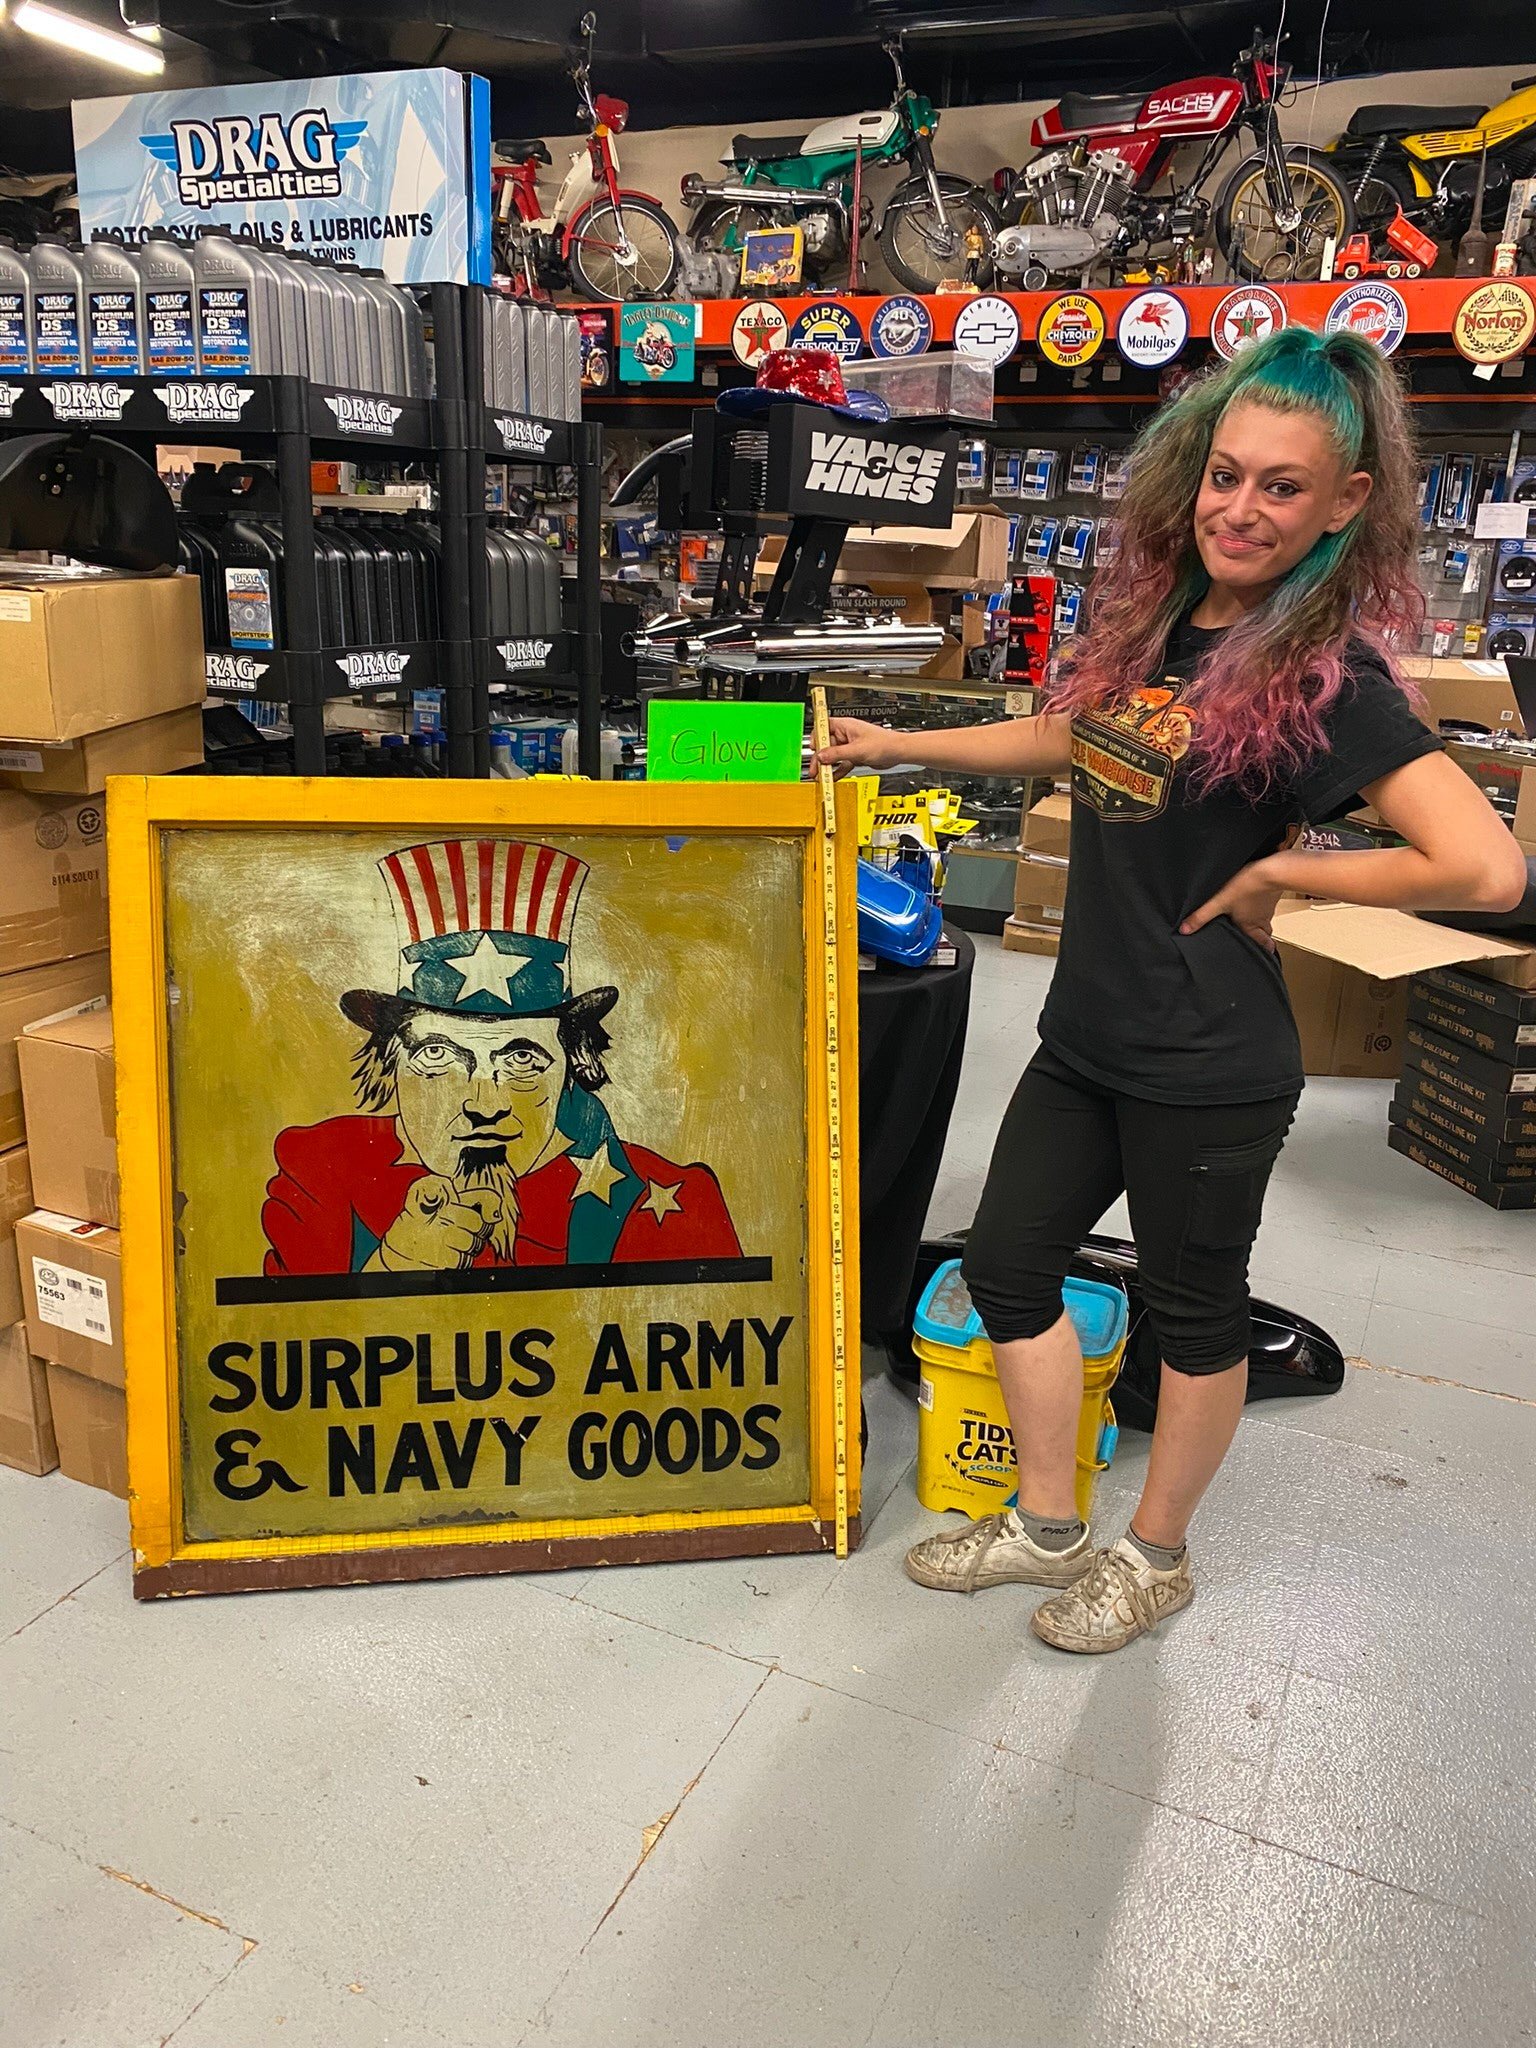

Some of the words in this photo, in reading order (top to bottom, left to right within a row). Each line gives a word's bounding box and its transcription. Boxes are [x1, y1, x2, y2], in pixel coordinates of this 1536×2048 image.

[1148, 95, 1214, 114] SACHS
[172, 109, 338, 177] DRAG
[180, 172, 339, 206] Specialties
[240, 221, 284, 243] OILS
[291, 220, 304, 242] &
[310, 213, 433, 242] LUBRICANTS
[44, 296, 67, 306] DRAG
[99, 295, 126, 306] DRAG
[156, 295, 182, 305] DRAG
[209, 291, 238, 302] DRAG
[1223, 290, 1277, 313] GASOLINE
[1347, 288, 1393, 304] AUTHORIZED
[876, 299, 926, 324] MUSTANG
[963, 300, 1013, 321] GENUINE
[1058, 298, 1071, 310] WE
[1074, 298, 1089, 309] USE
[37, 312, 75, 320] PREMIUM
[92, 312, 134, 320] PREMIUM
[149, 311, 190, 320] PREMIUM
[202, 309, 246, 317] PREMIUM
[800, 307, 851, 330] SUPER
[740, 317, 781, 327] TEXACO
[1460, 309, 1527, 333] Norton
[1048, 329, 1097, 340] CHEVROLET
[795, 341, 857, 353] CHEVROLET
[1127, 335, 1176, 351] Mobilgas
[1057, 353, 1083, 363] PARTS
[54, 384, 120, 408] DRAG
[168, 384, 239, 410] DRAG
[55, 406, 120, 421] Specialties
[169, 407, 239, 422] Specialties
[336, 396, 394, 424] DRAG
[338, 418, 392, 434] Specialties
[502, 418, 545, 444] DRAG
[503, 437, 545, 451] Specialties
[811, 431, 946, 477] VANCE
[805, 461, 937, 504] HINES
[234, 573, 260, 584] DRAG
[832, 599, 852, 607] TWIN
[854, 599, 878, 607] SLASH
[880, 598, 906, 607] ROUND
[506, 640, 546, 662] DRAG
[206, 656, 254, 679] RAG
[350, 652, 400, 677] DRAG
[507, 657, 545, 669] Specialties
[206, 674, 254, 689] ecialties
[350, 672, 400, 687] Specialties
[1011, 693, 1024, 711] 3
[833, 708, 869, 716] MONSTER
[871, 707, 897, 715] ROUND
[671, 729, 769, 765] Glove
[1087, 745, 1155, 798] WAREHOUSE
[873, 813, 917, 825] THOR
[1485, 995, 1496, 1005] KIT
[1475, 1091, 1486, 1101] KIT
[1475, 1115, 1486, 1125] KIT
[1466, 1133, 1477, 1144] KIT
[1460, 1154, 1471, 1164] KIT
[1466, 1184, 1477, 1194] KIT
[37, 1285, 66, 1302] 75563
[207, 1328, 557, 1413] SURPLUS
[583, 1316, 793, 1395] ARMY
[213, 1428, 309, 1501] &
[328, 1415, 539, 1498] NAVY
[567, 1403, 783, 1482] GOODS
[957, 1441, 1018, 1465] CATS
[970, 1464, 1012, 1473] SCOOP
